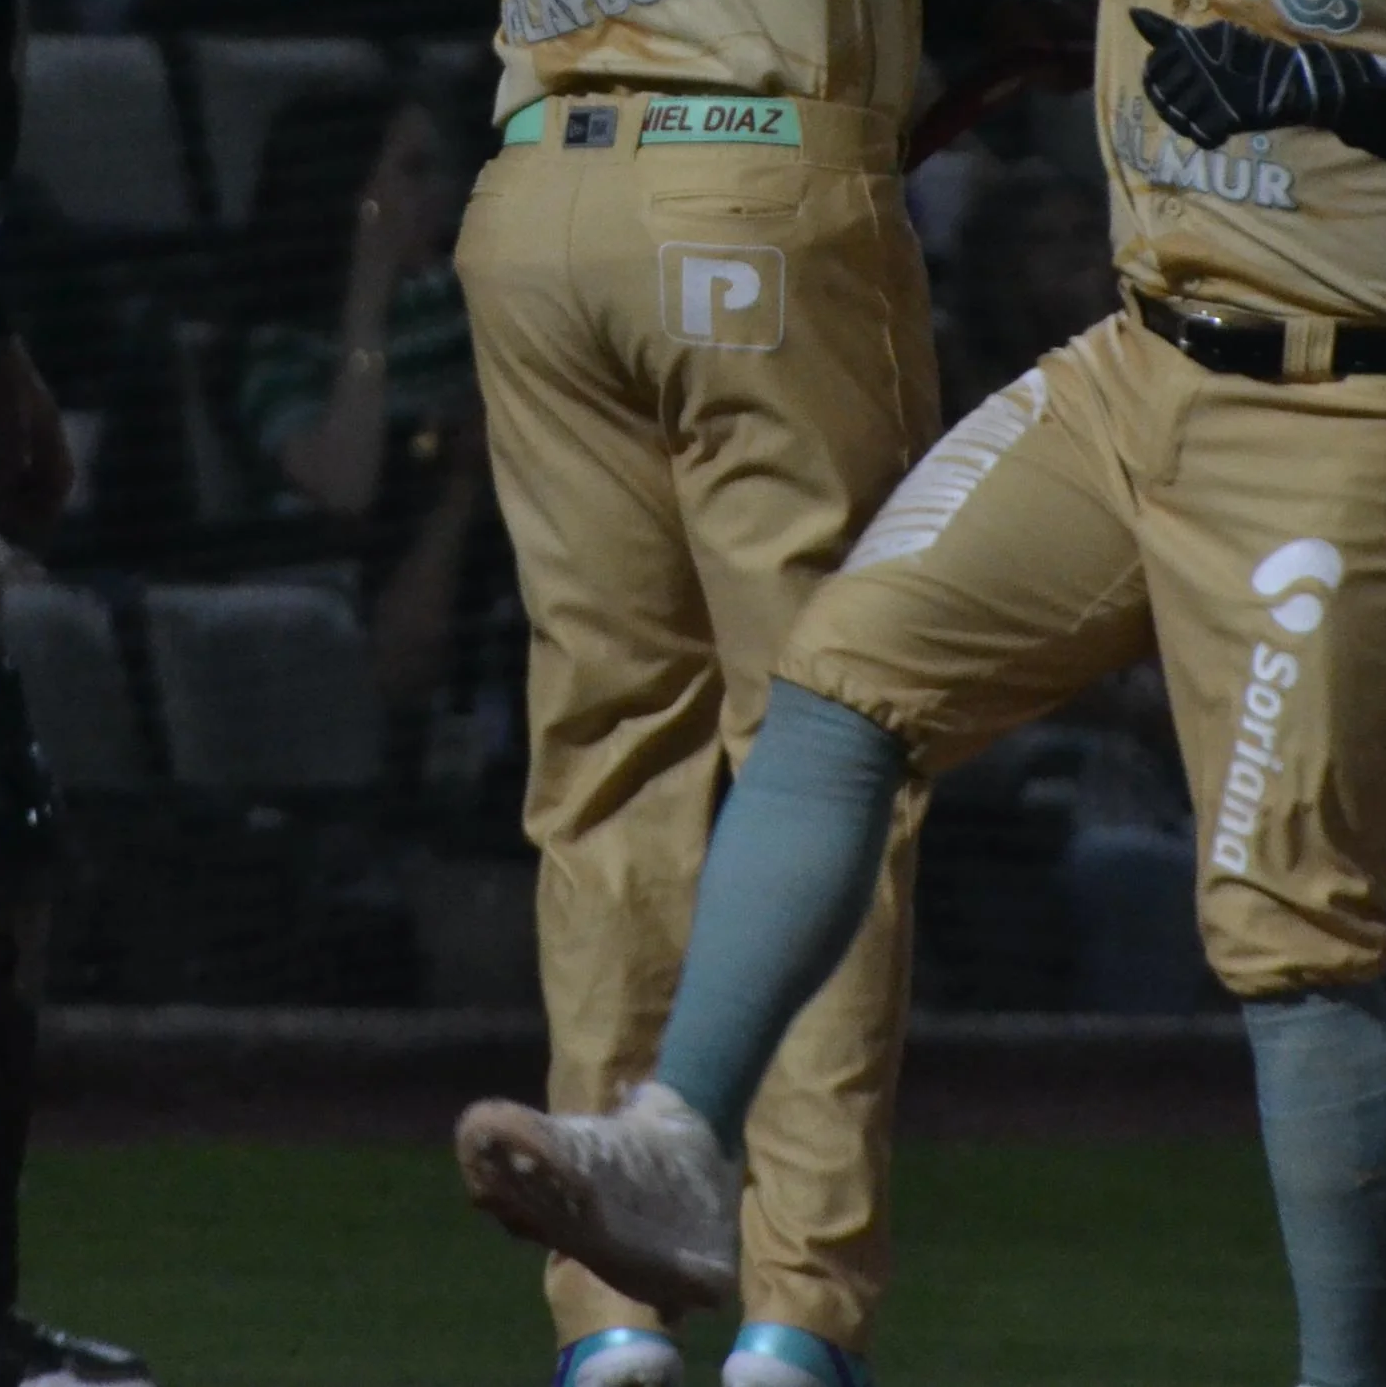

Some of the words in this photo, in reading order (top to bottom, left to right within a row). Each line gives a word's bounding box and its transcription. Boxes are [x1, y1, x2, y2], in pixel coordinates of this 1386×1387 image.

[703, 105, 784, 134] DIAZ
[1155, 138, 1299, 210] MUR
[681, 255, 762, 336] P
[1213, 641, 1300, 874] Soriana
